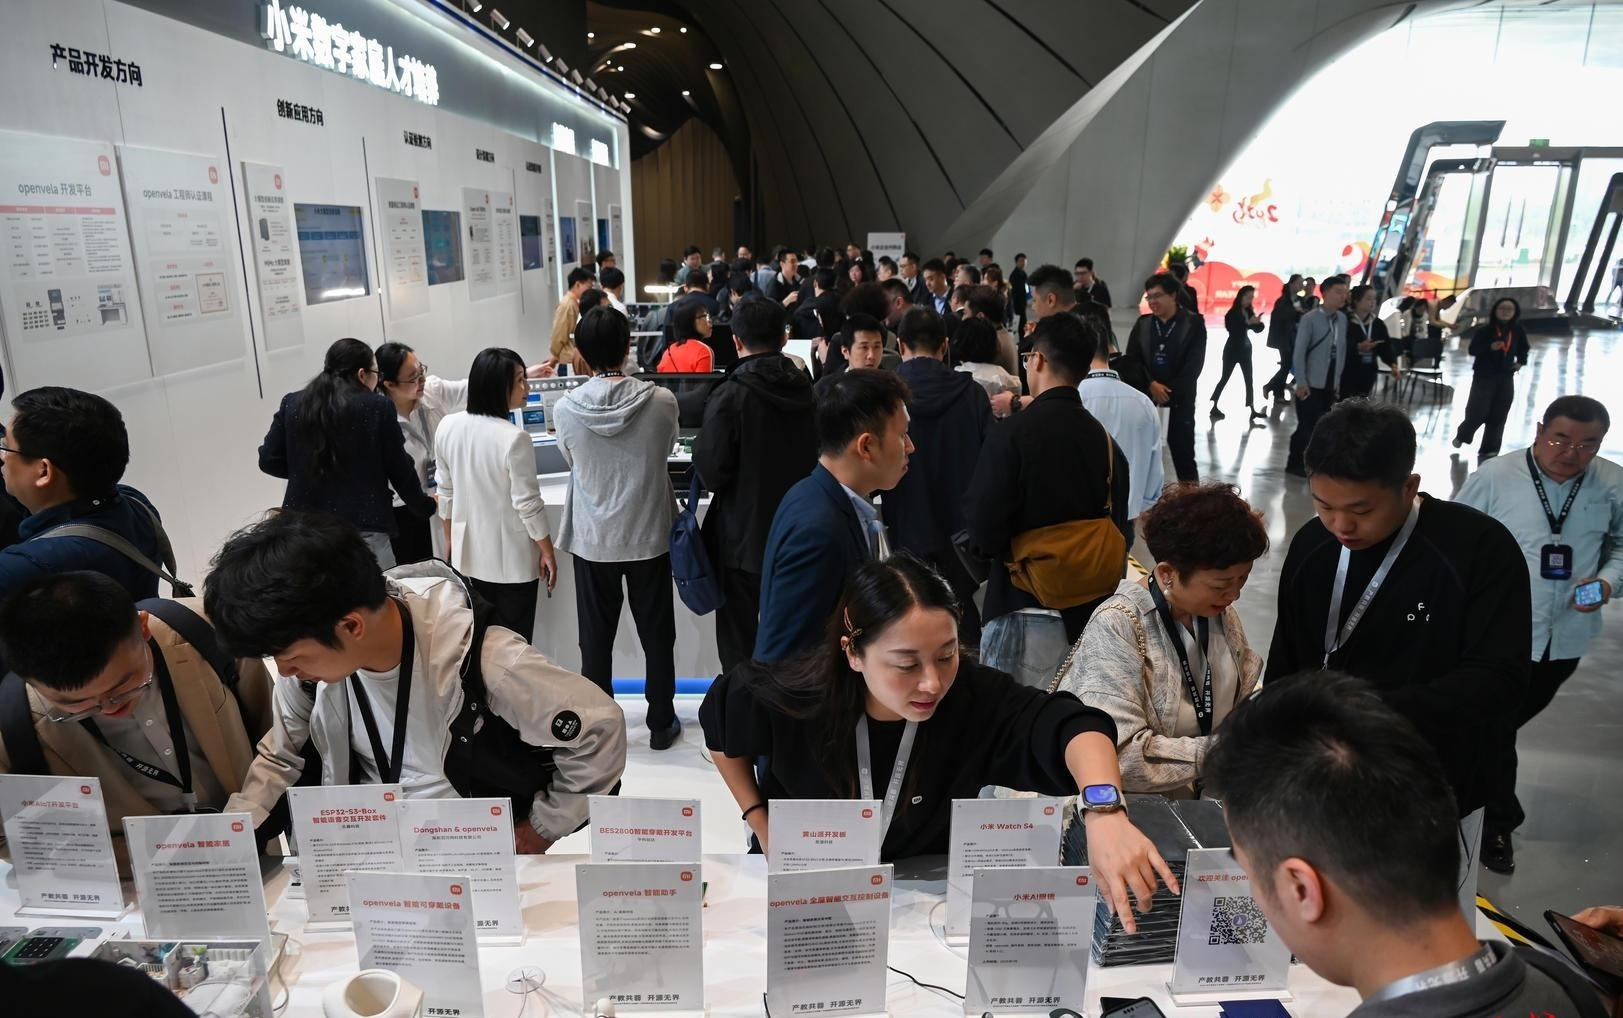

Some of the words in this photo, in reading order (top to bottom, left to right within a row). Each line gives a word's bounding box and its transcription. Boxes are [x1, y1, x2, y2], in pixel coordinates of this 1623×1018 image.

[50, 43, 143, 87] 产品开发方向
[277, 98, 324, 126] 创新应用方向
[18, 182, 59, 196] openvela
[60, 183, 92, 197] 开发平台
[320, 808, 377, 816] ESP32-S3-Box
[312, 814, 387, 824] 智能语音交互开发套件
[413, 826, 453, 835] Dongshan
[599, 827, 693, 837] BES2800智能穿戴开发平台
[155, 842, 195, 850] openvela
[197, 840, 231, 848] 智能家居
[1198, 874, 1230, 882] 欢迎关注
[603, 890, 642, 898] openvela
[644, 889, 677, 897] 智能助手
[1014, 893, 1056, 901] 小米AI眼镜
[362, 899, 402, 908] openvela
[403, 900, 461, 910] 智能可穿戴设备
[769, 899, 808, 908] openvela
[427, 1008, 461, 1016] 开源无界
